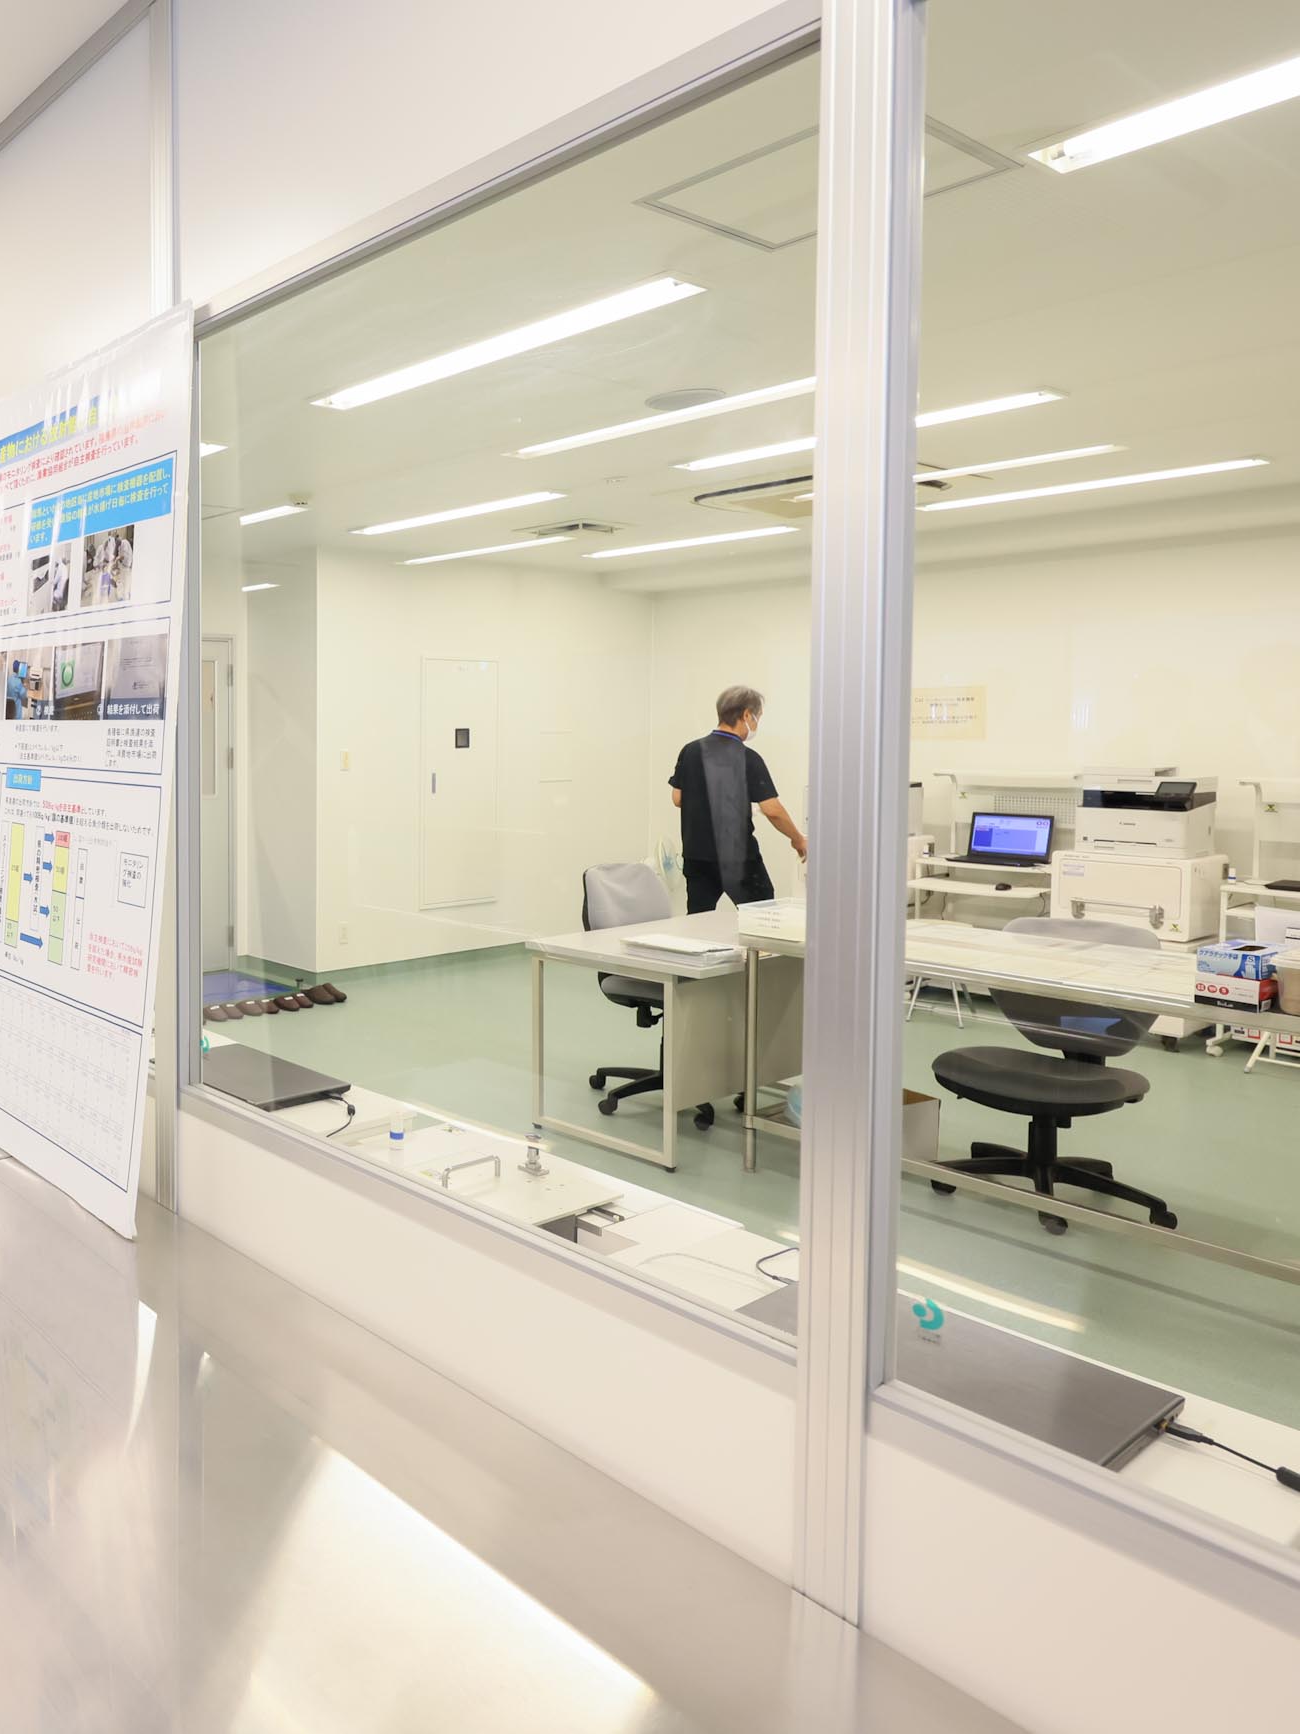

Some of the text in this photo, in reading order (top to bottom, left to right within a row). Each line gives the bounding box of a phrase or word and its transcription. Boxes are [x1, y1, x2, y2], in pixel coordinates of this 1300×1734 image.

[106, 701, 160, 717] 結果を添付して出荷
